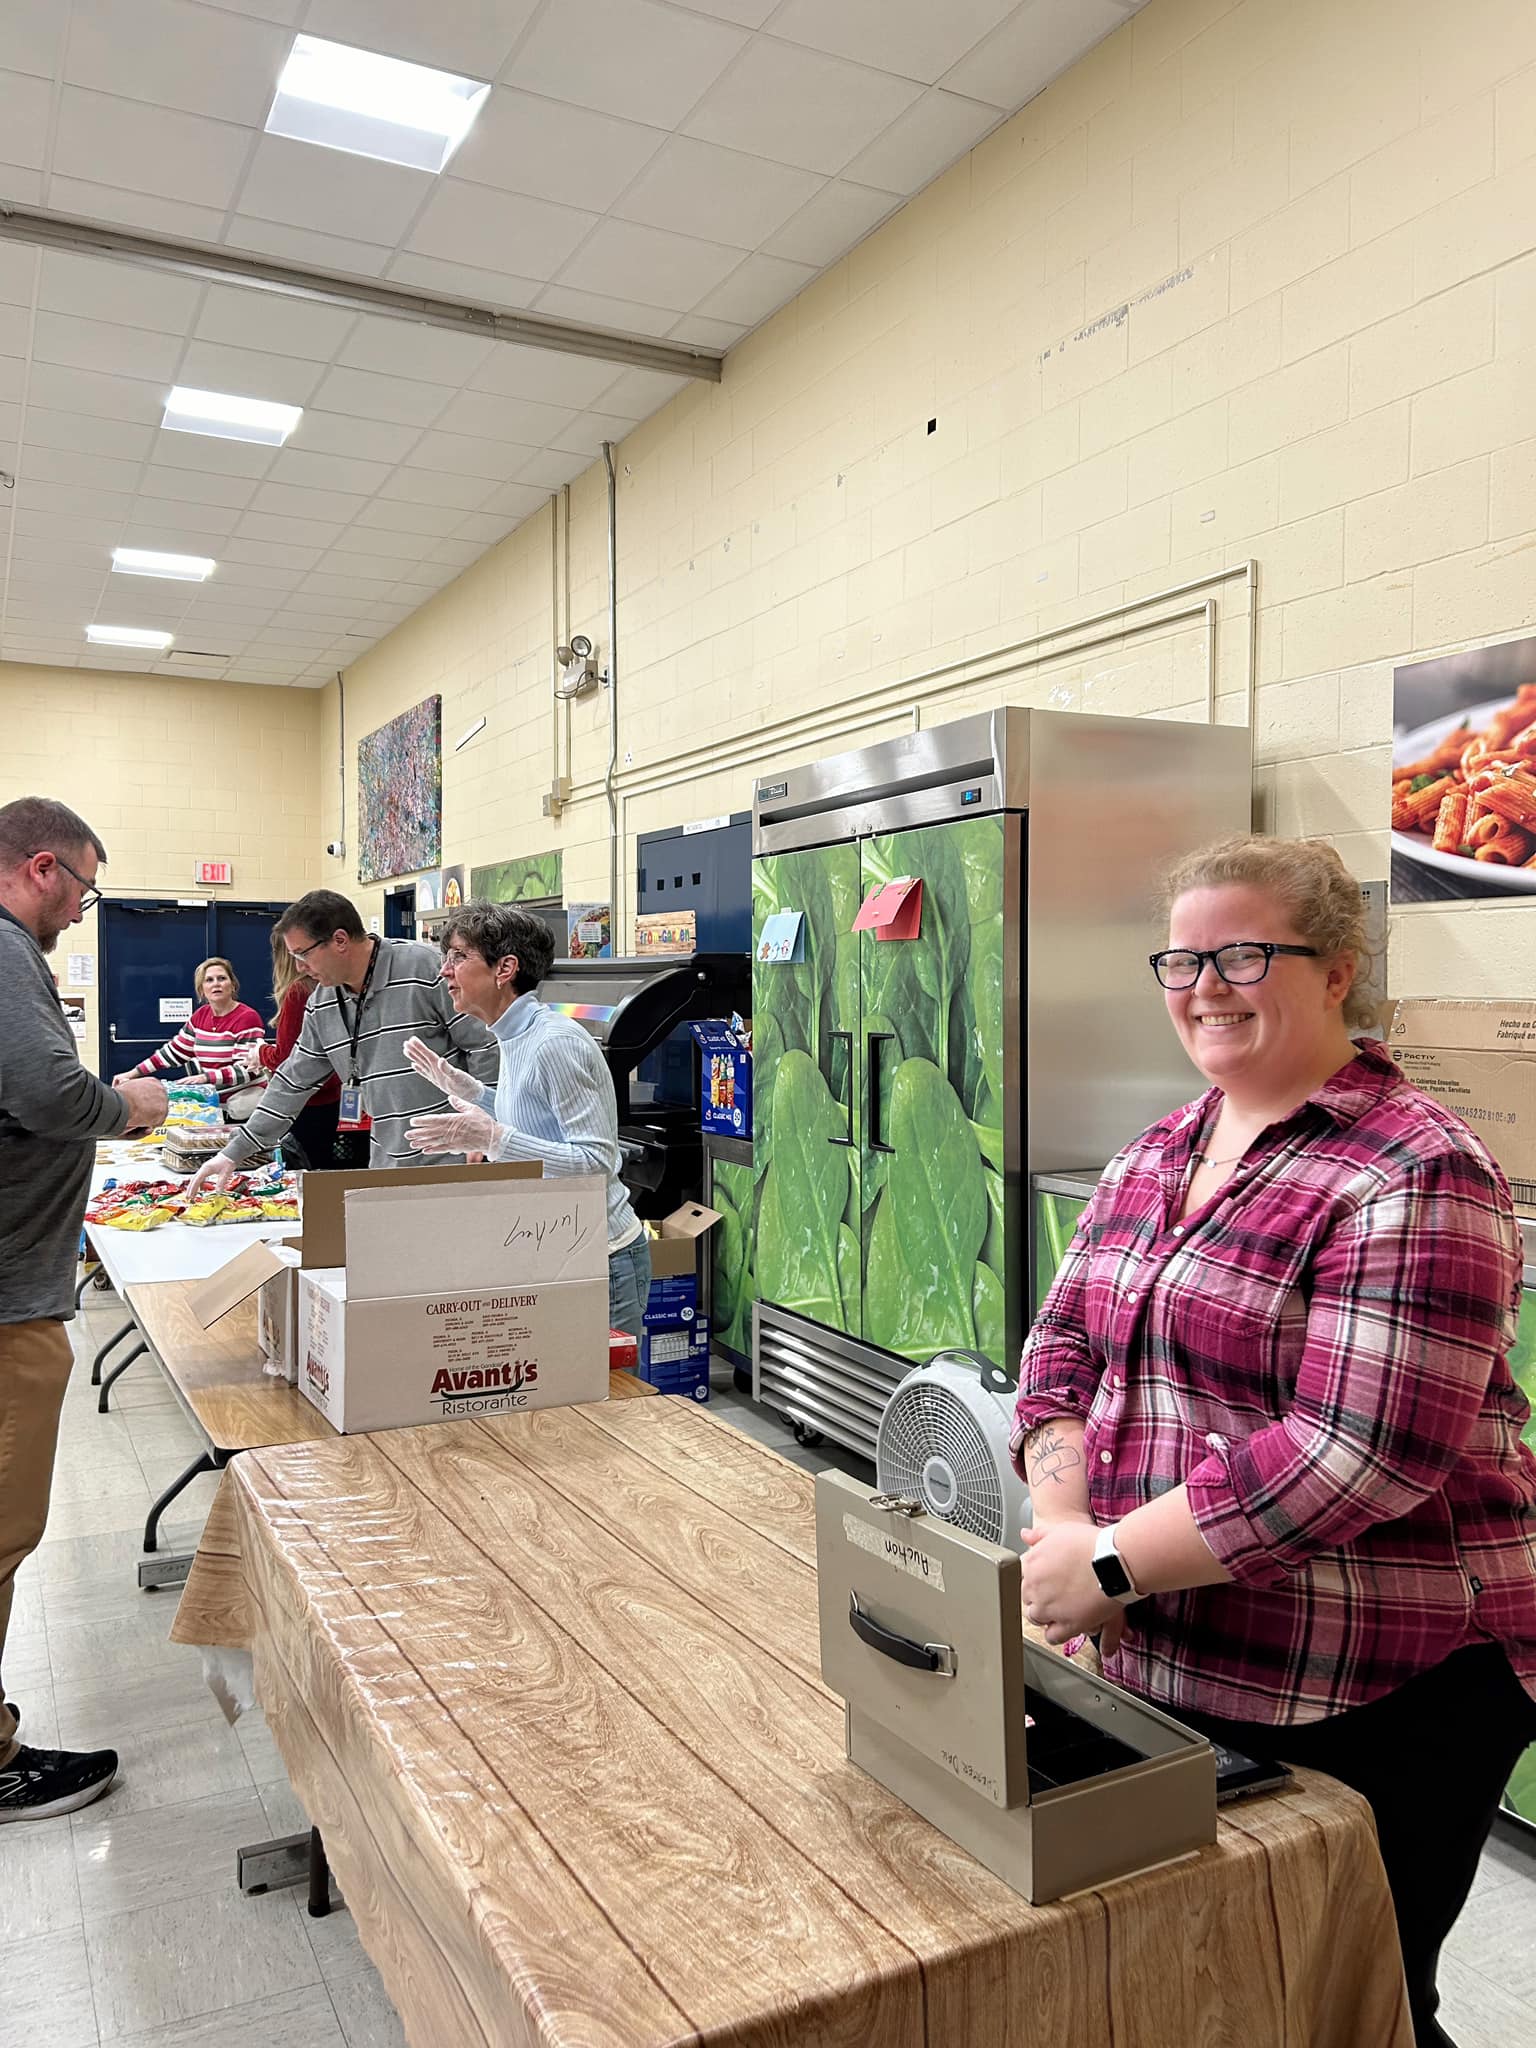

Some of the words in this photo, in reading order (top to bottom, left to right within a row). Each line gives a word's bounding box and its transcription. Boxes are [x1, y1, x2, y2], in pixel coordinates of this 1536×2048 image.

[202, 863, 226, 881] EXIT
[426, 1300, 482, 1315] CARRY-OUT
[491, 1294, 538, 1310] DELIVERY
[682, 1309, 693, 1317] 50
[430, 1360, 538, 1394] Avanti's
[442, 1394, 528, 1415] Ristorante
[885, 1540, 929, 1576] Auction
